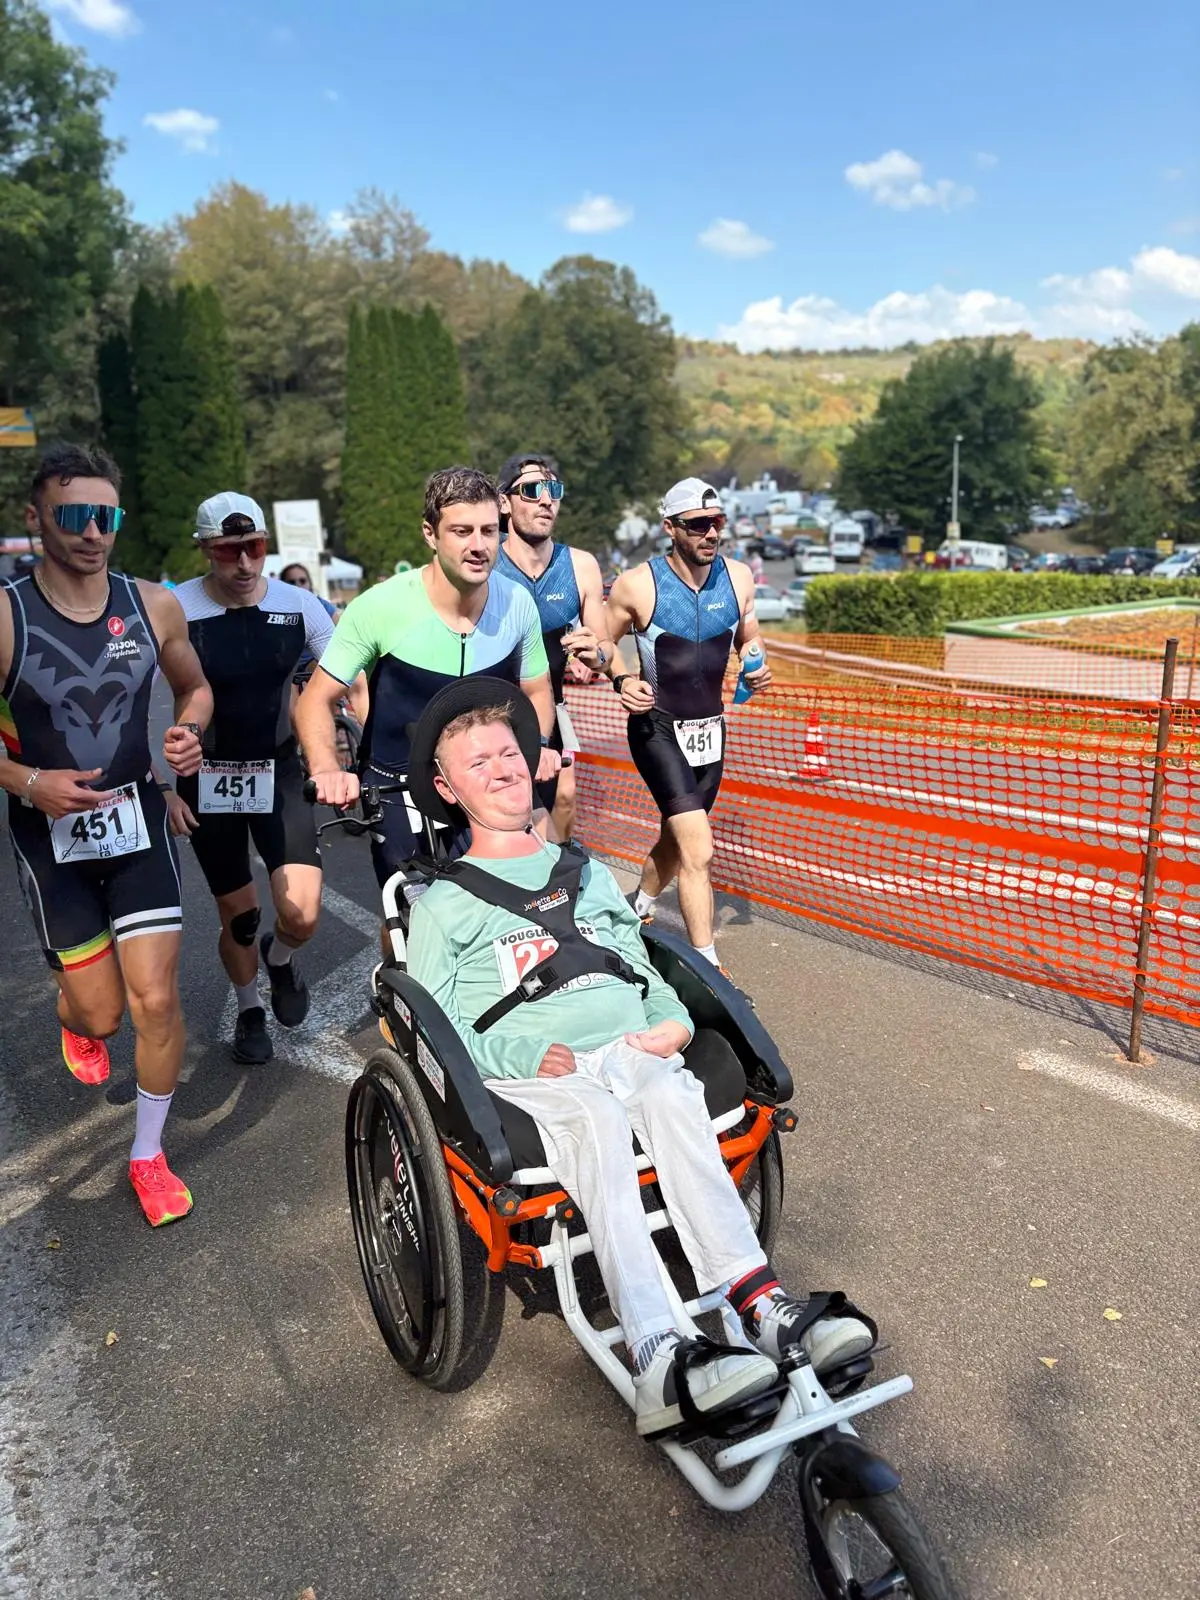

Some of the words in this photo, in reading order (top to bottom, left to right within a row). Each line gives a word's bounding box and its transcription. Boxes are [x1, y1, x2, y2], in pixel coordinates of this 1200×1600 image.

[546, 592, 565, 602] POLI
[707, 601, 725, 611] POLI
[105, 639, 137, 652] DIJON
[686, 730, 712, 753] 451
[213, 775, 256, 798] 451
[70, 807, 125, 843] 451
